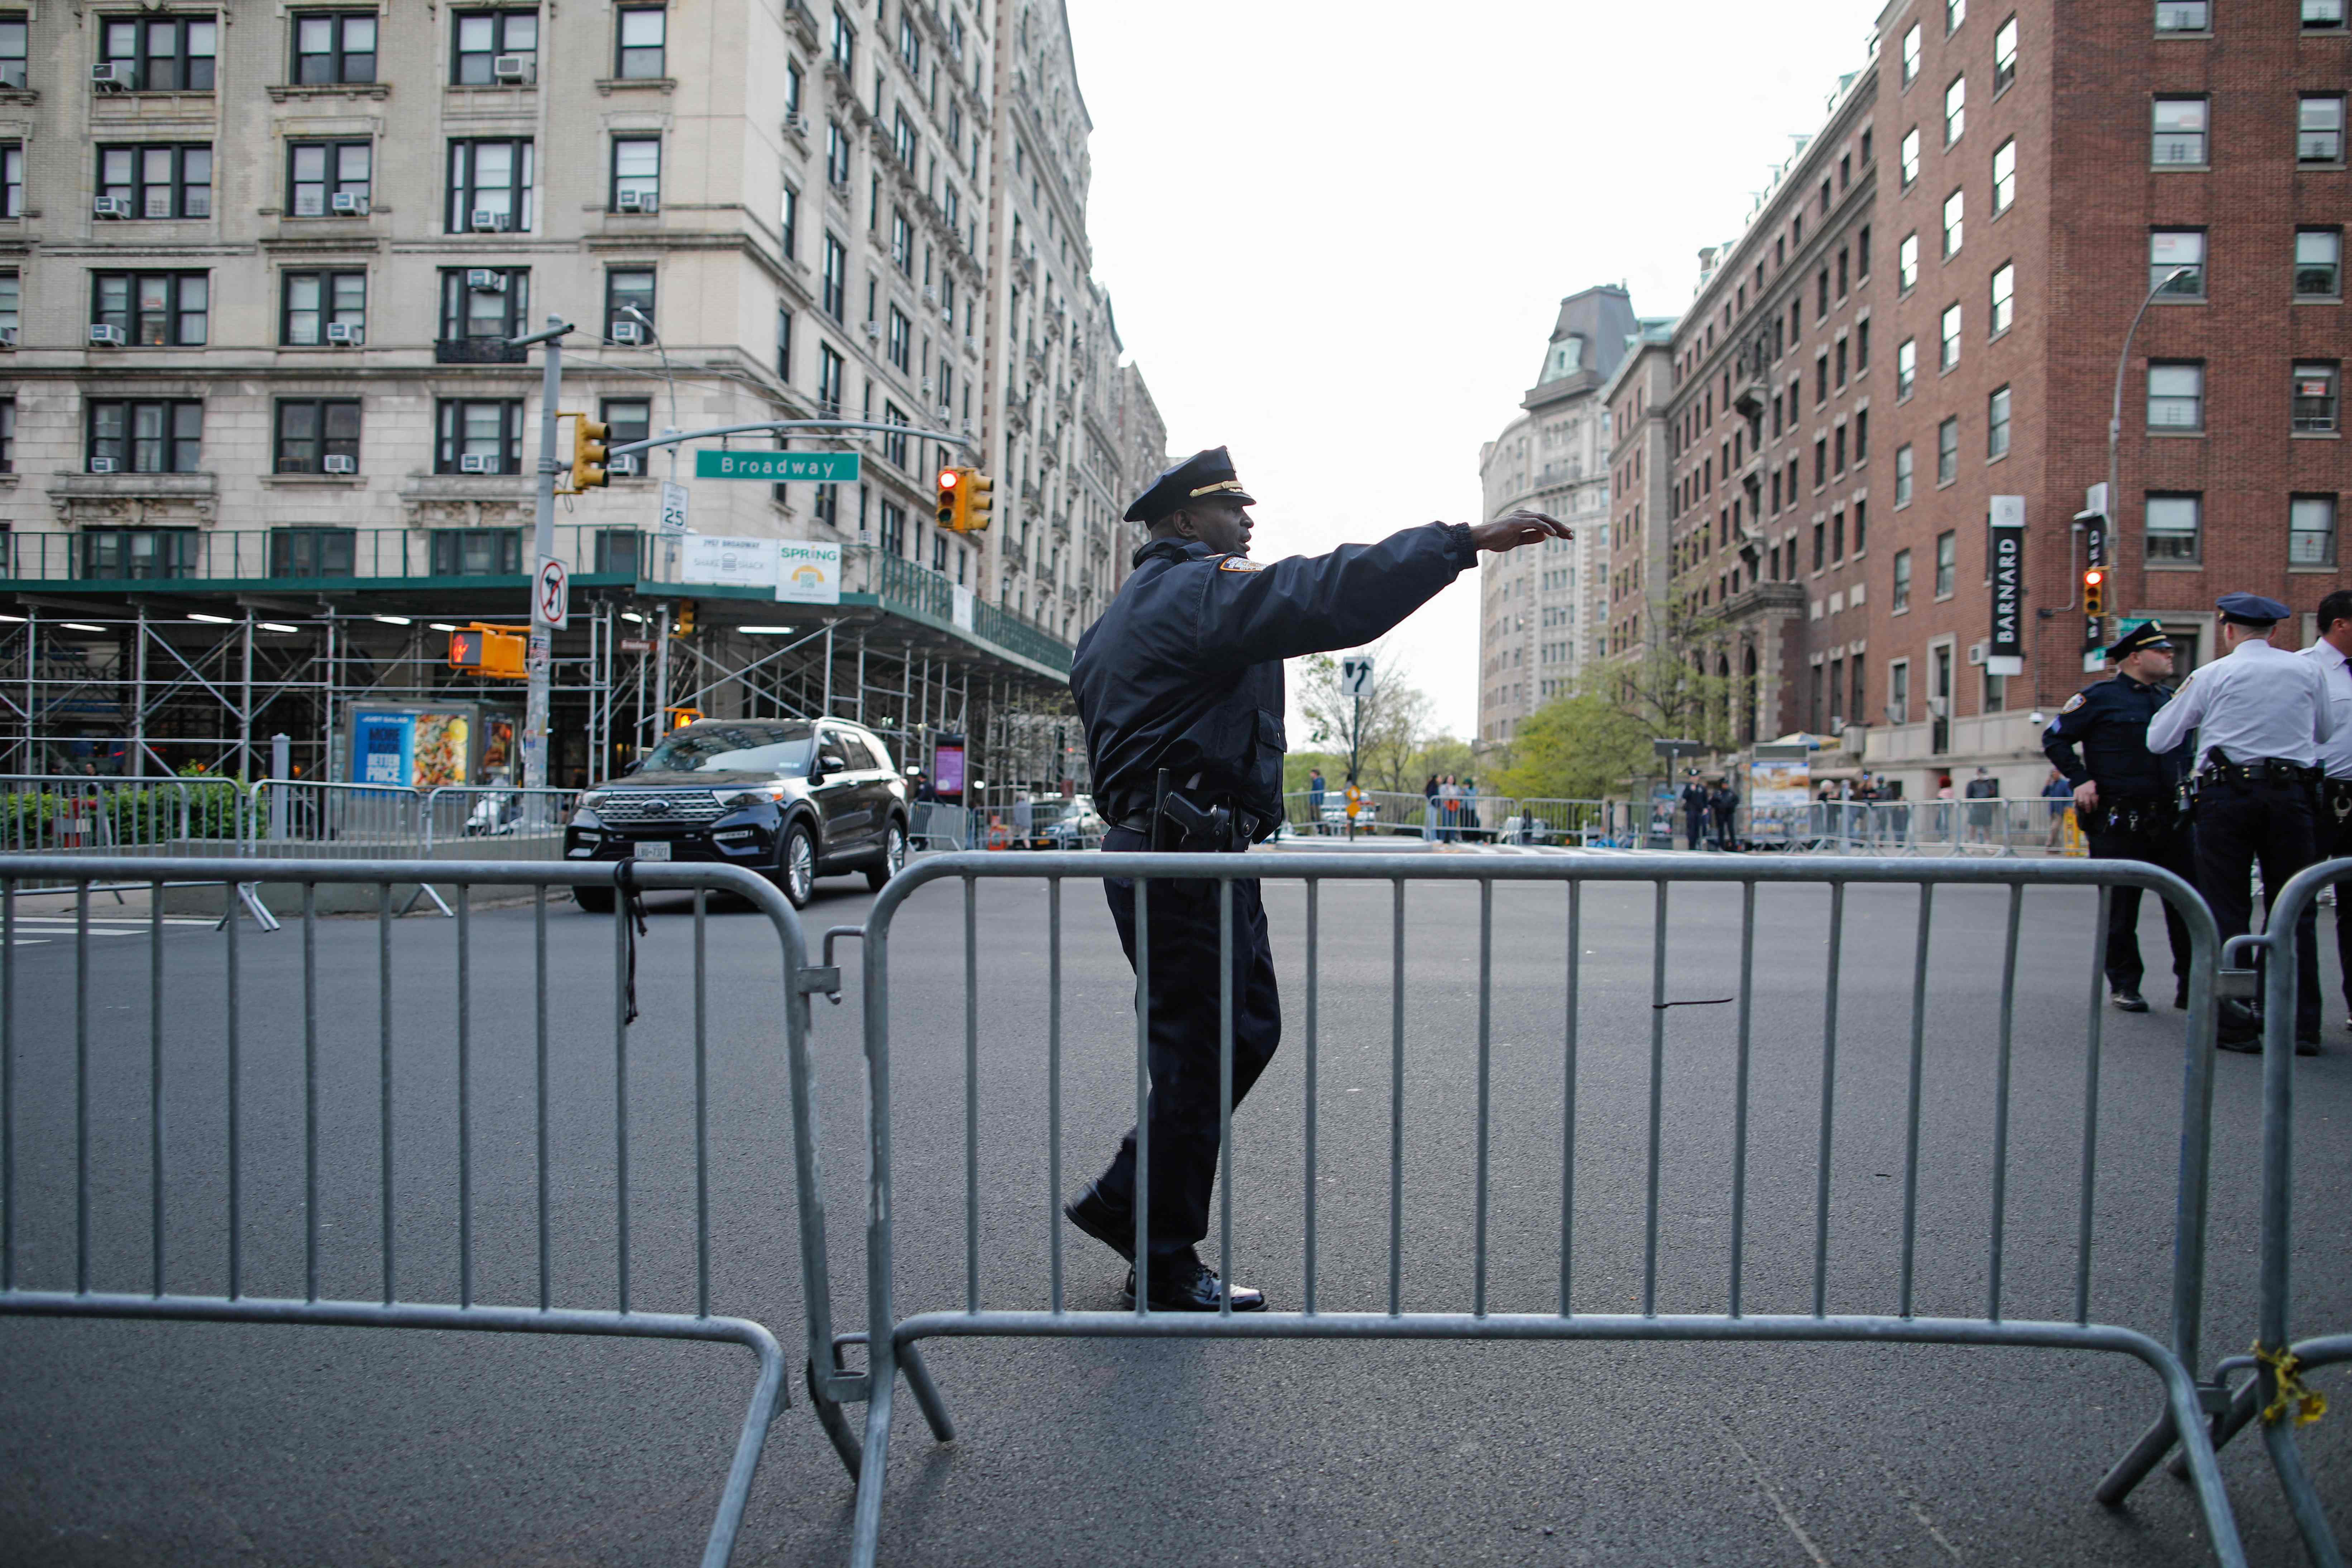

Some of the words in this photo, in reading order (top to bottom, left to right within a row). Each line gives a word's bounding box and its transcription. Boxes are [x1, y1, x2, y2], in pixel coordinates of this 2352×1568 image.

[722, 457, 834, 478] Broadway
[665, 507, 684, 526] 25
[694, 557, 720, 567] SHAKE
[737, 561, 764, 569] SHACK
[1997, 538, 2016, 643] BARNARD
[369, 728, 401, 741] MORE
[367, 753, 400, 766] BETTER
